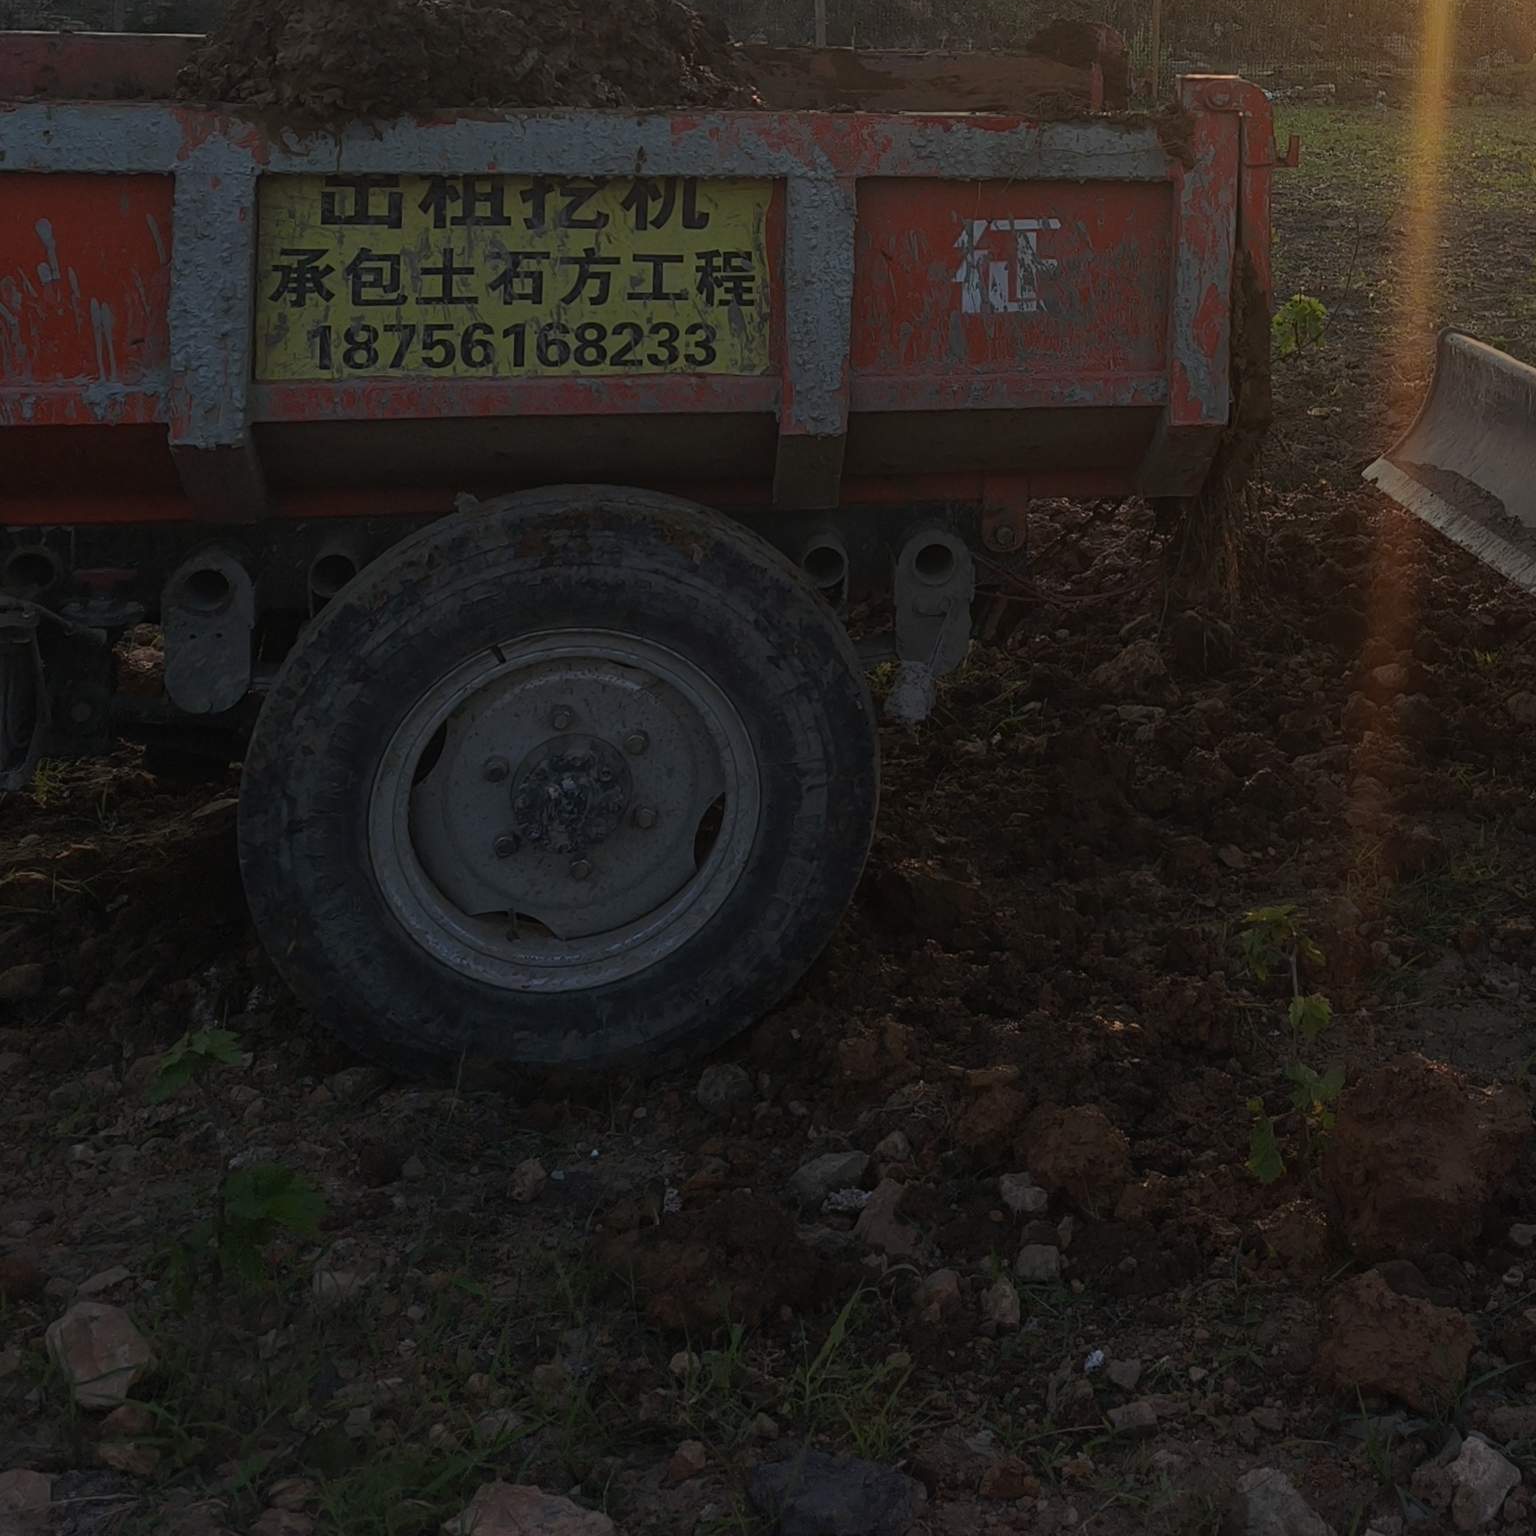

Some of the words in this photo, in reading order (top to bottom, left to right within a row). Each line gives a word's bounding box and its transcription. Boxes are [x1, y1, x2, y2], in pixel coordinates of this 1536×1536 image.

[268, 247, 756, 308] 承包土石方工程
[311, 321, 718, 371] 18756168233
